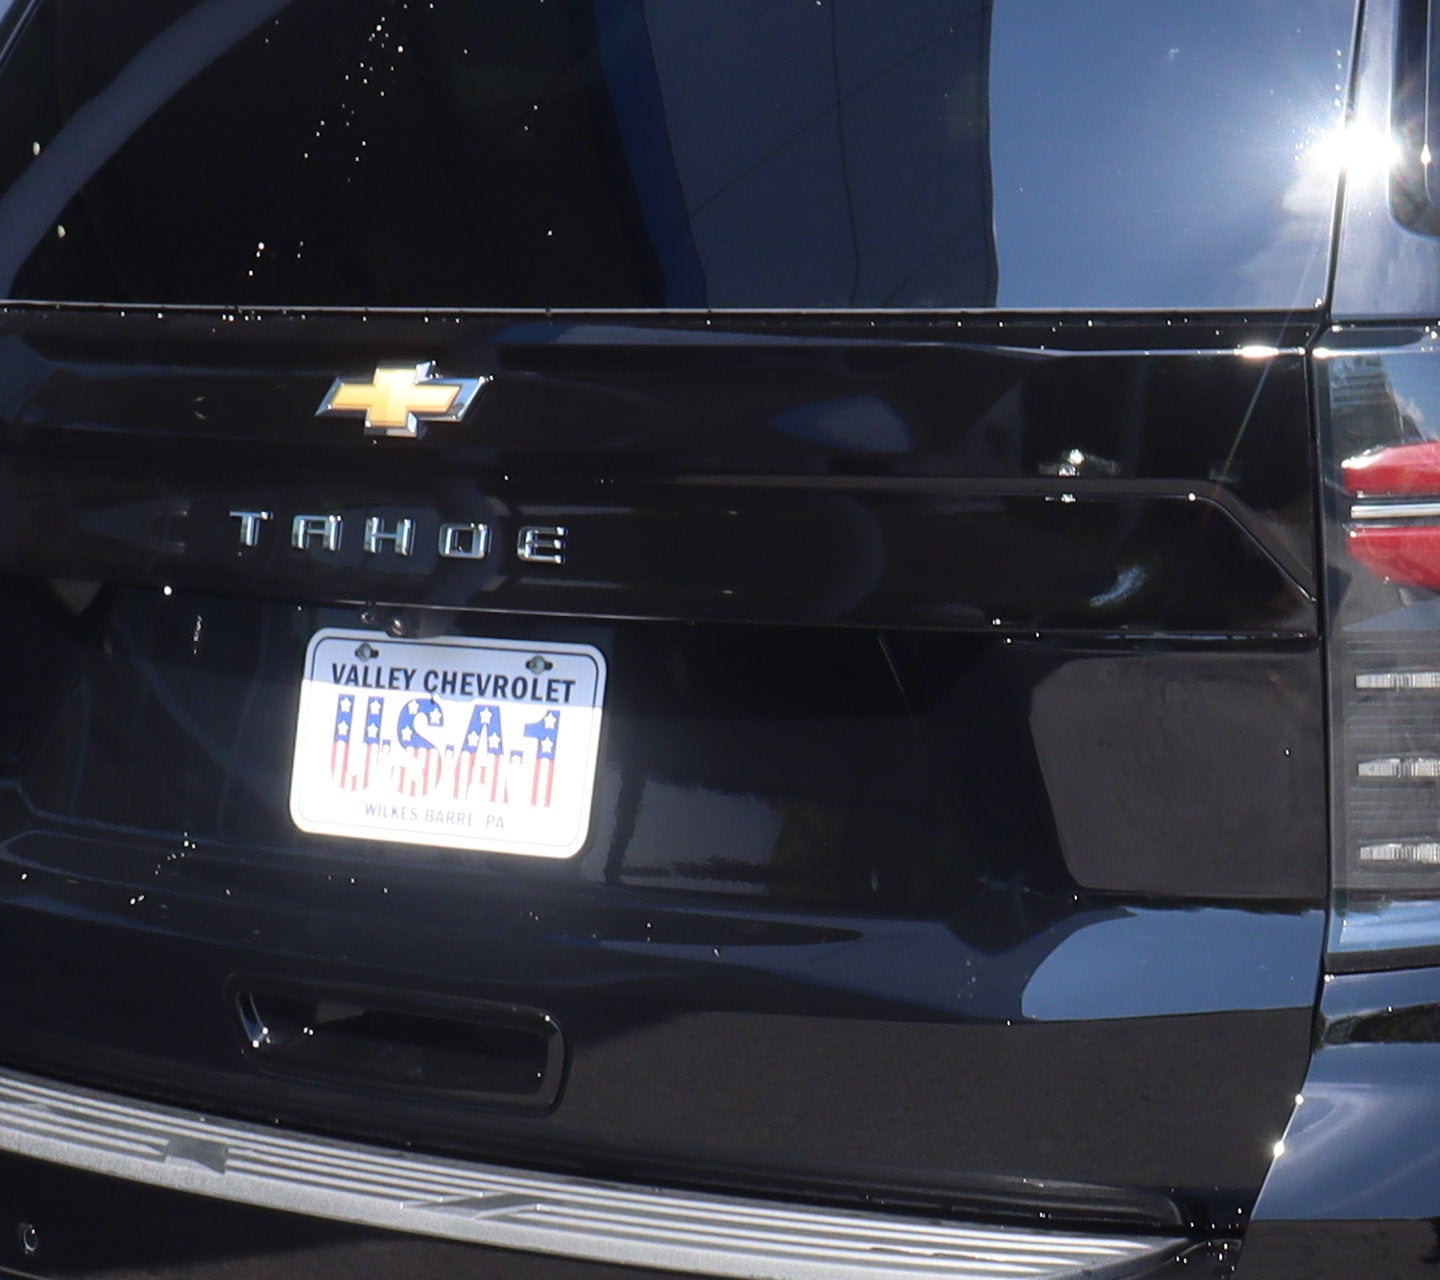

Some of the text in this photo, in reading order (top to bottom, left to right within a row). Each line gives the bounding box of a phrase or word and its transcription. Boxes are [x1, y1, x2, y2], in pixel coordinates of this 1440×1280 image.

[229, 510, 569, 565] TAHOE
[331, 662, 576, 704] VALLEY CHEVROLET
[364, 803, 418, 822] WILKES
[485, 814, 505, 830] PA
